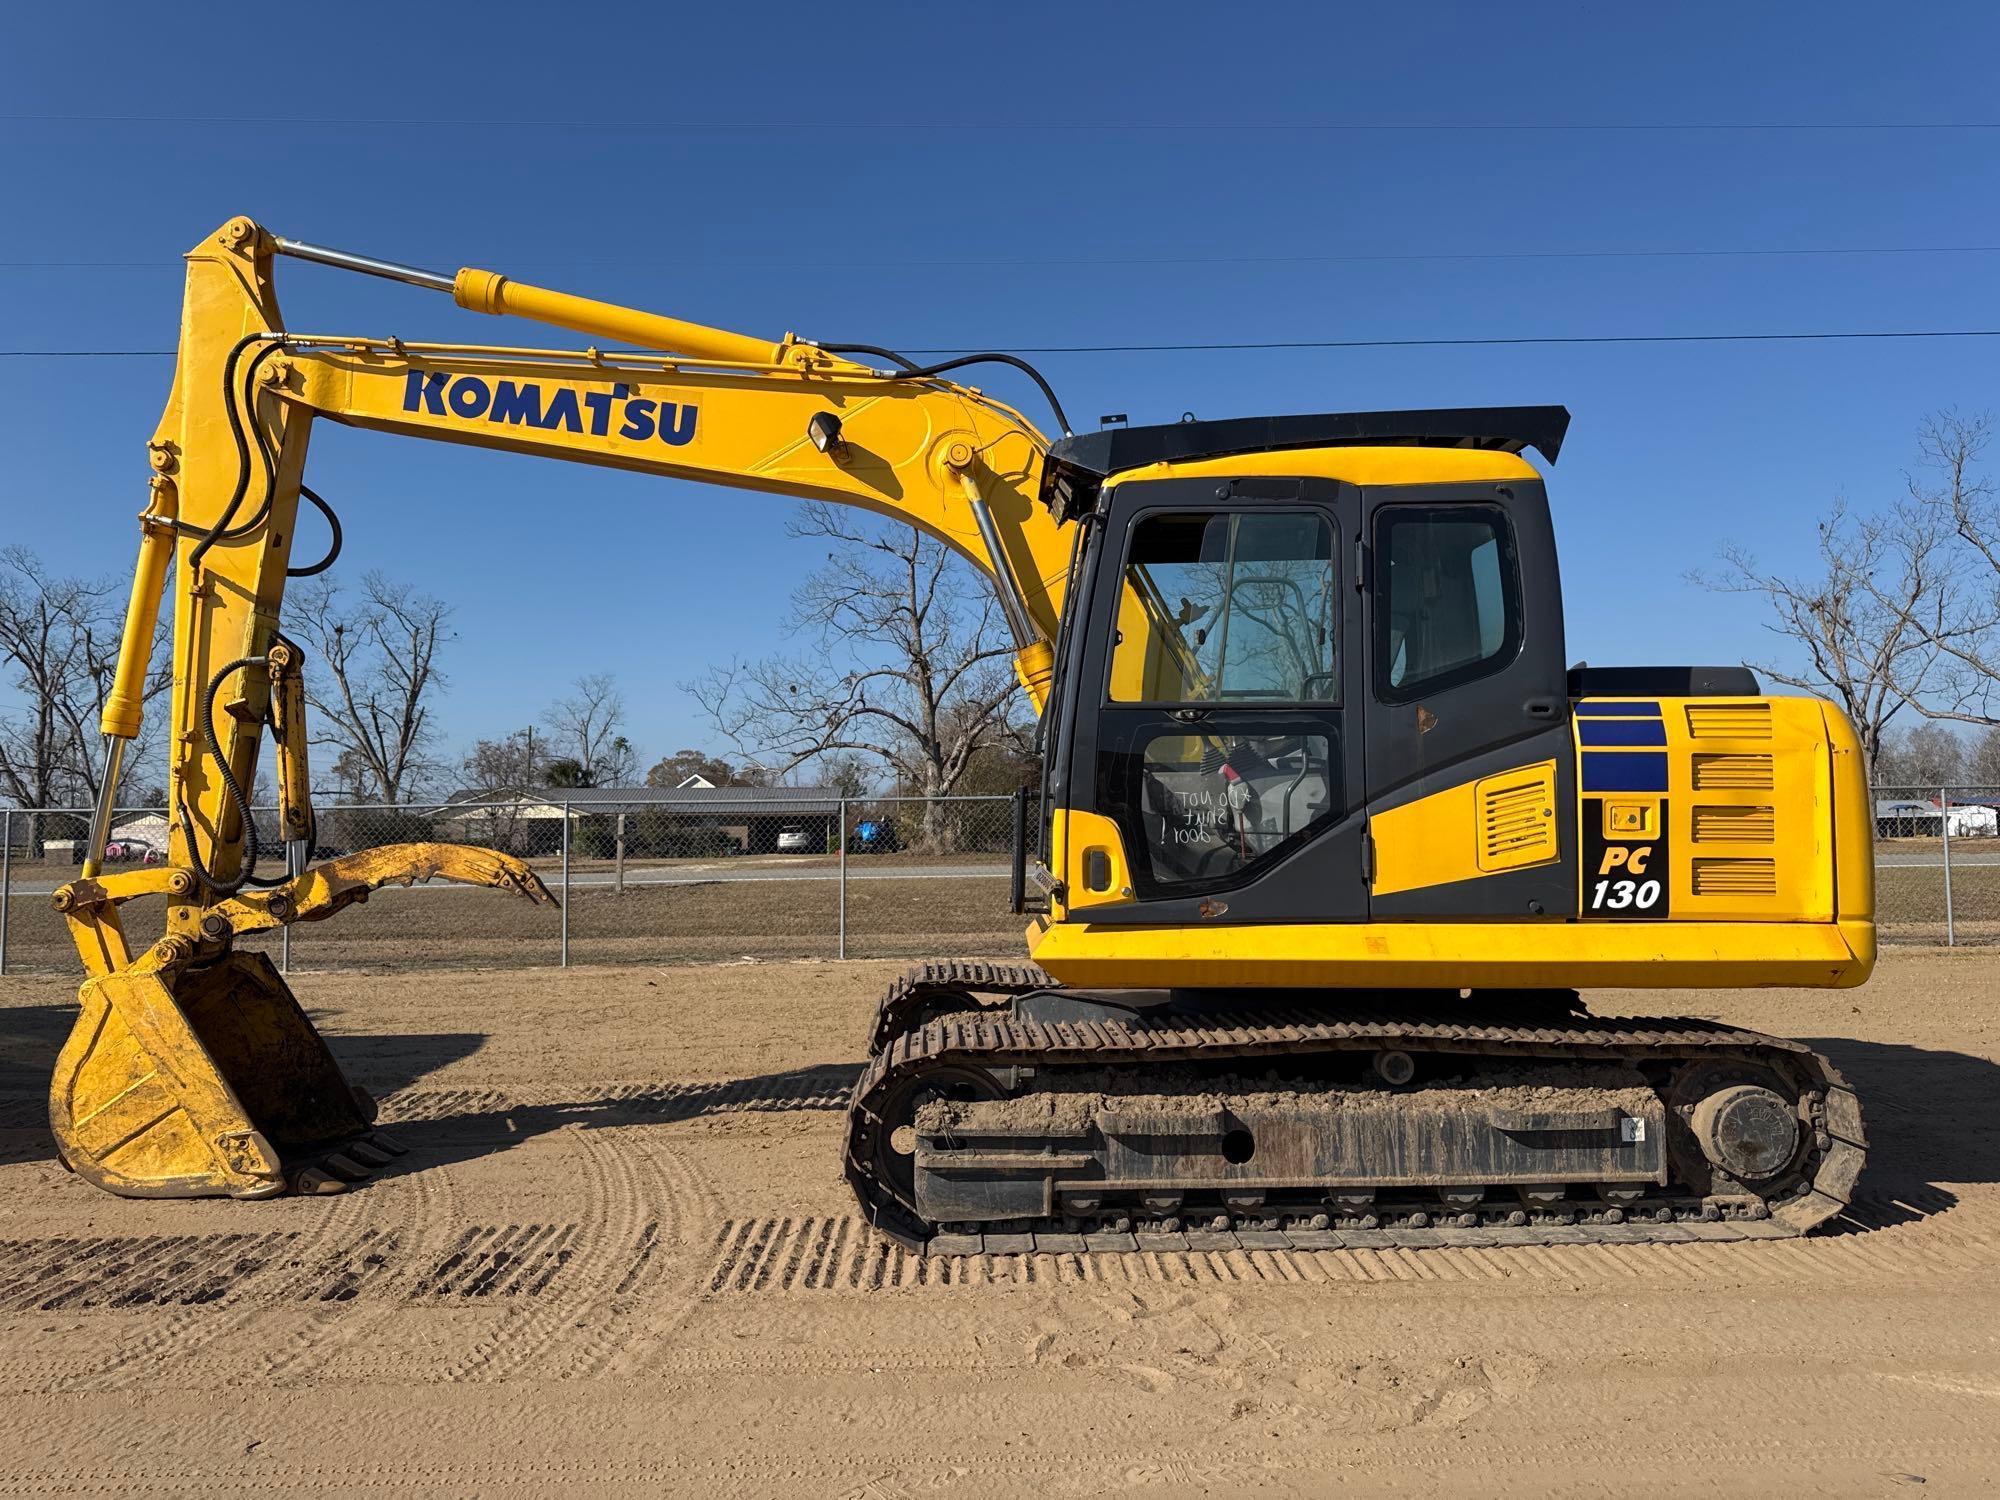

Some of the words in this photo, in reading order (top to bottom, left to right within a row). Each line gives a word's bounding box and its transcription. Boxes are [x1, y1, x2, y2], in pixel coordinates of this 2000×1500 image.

[403, 369, 698, 446] KOMATSU
[1599, 847, 1652, 875] PC
[1592, 880, 1661, 909] 130
